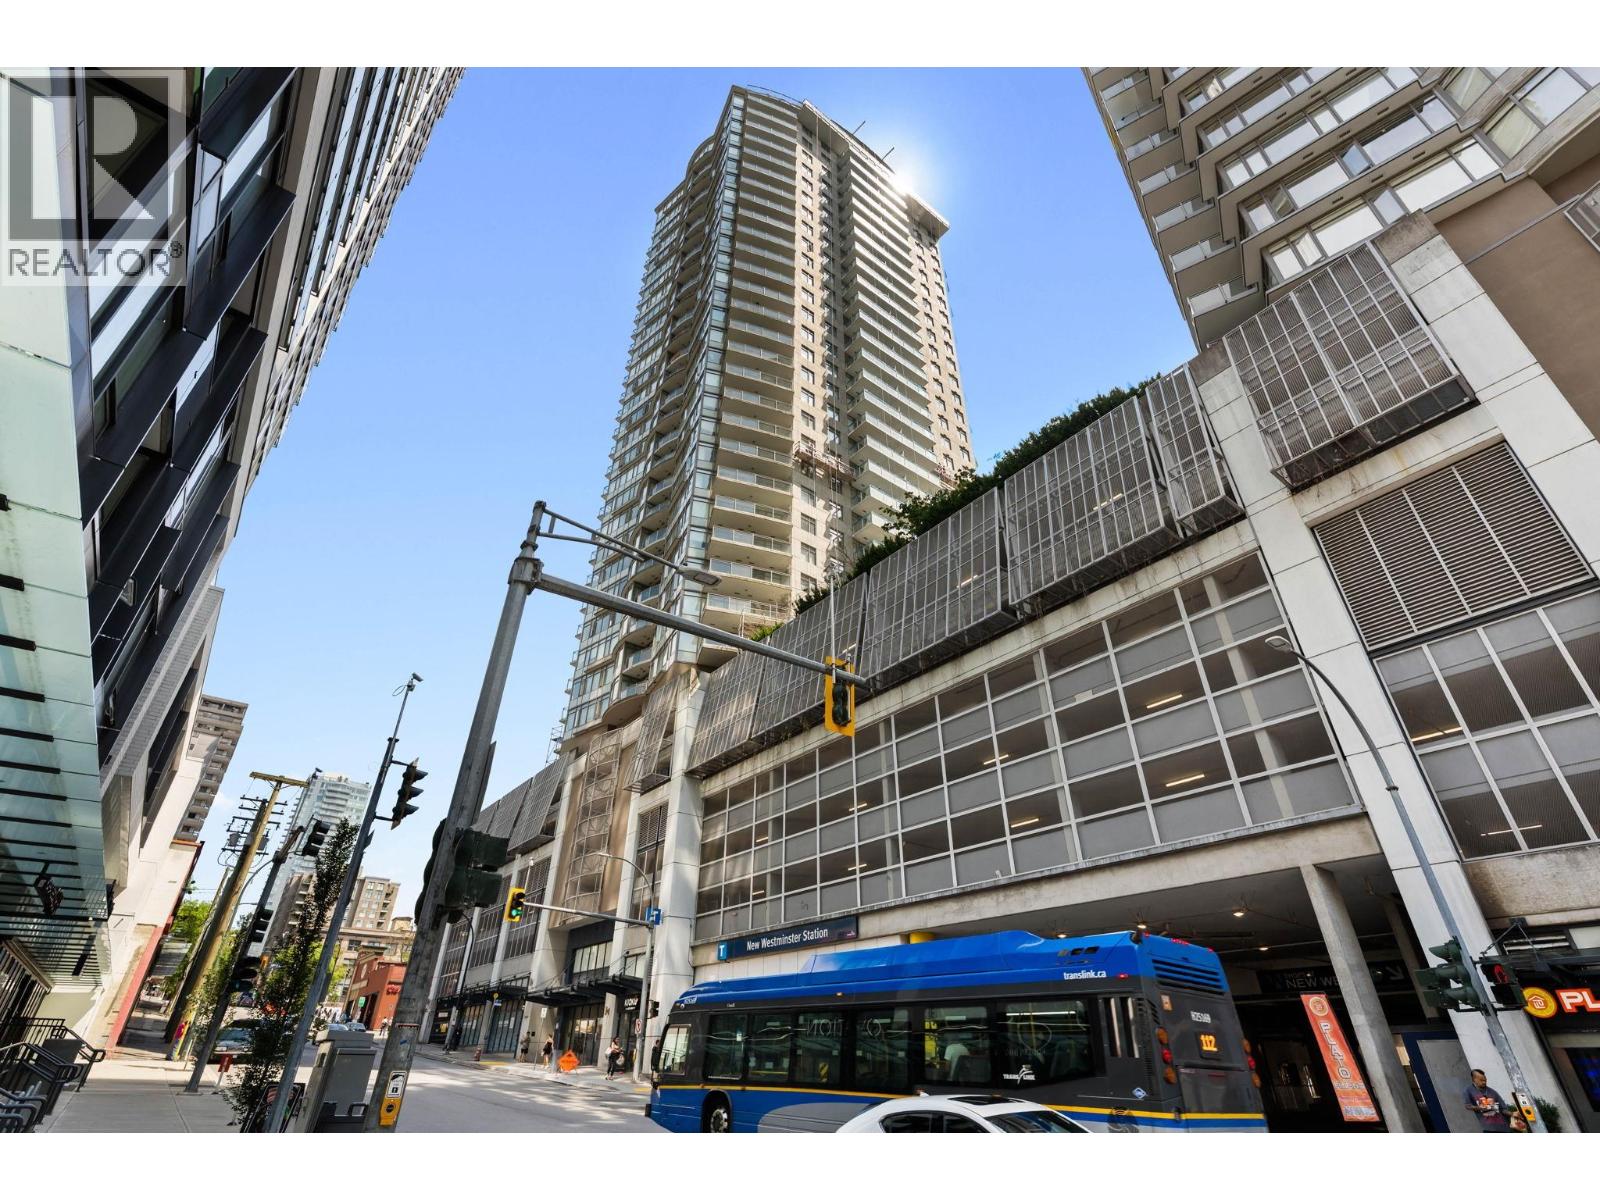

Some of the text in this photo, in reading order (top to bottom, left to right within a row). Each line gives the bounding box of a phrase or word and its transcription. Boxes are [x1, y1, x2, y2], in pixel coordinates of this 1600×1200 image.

[746, 940, 760, 952] New
[761, 933, 801, 948] Westminster
[803, 927, 829, 941] Station
[719, 944, 725, 957] T
[1063, 970, 1107, 981] translink.ca
[1200, 1034, 1218, 1051] 112
